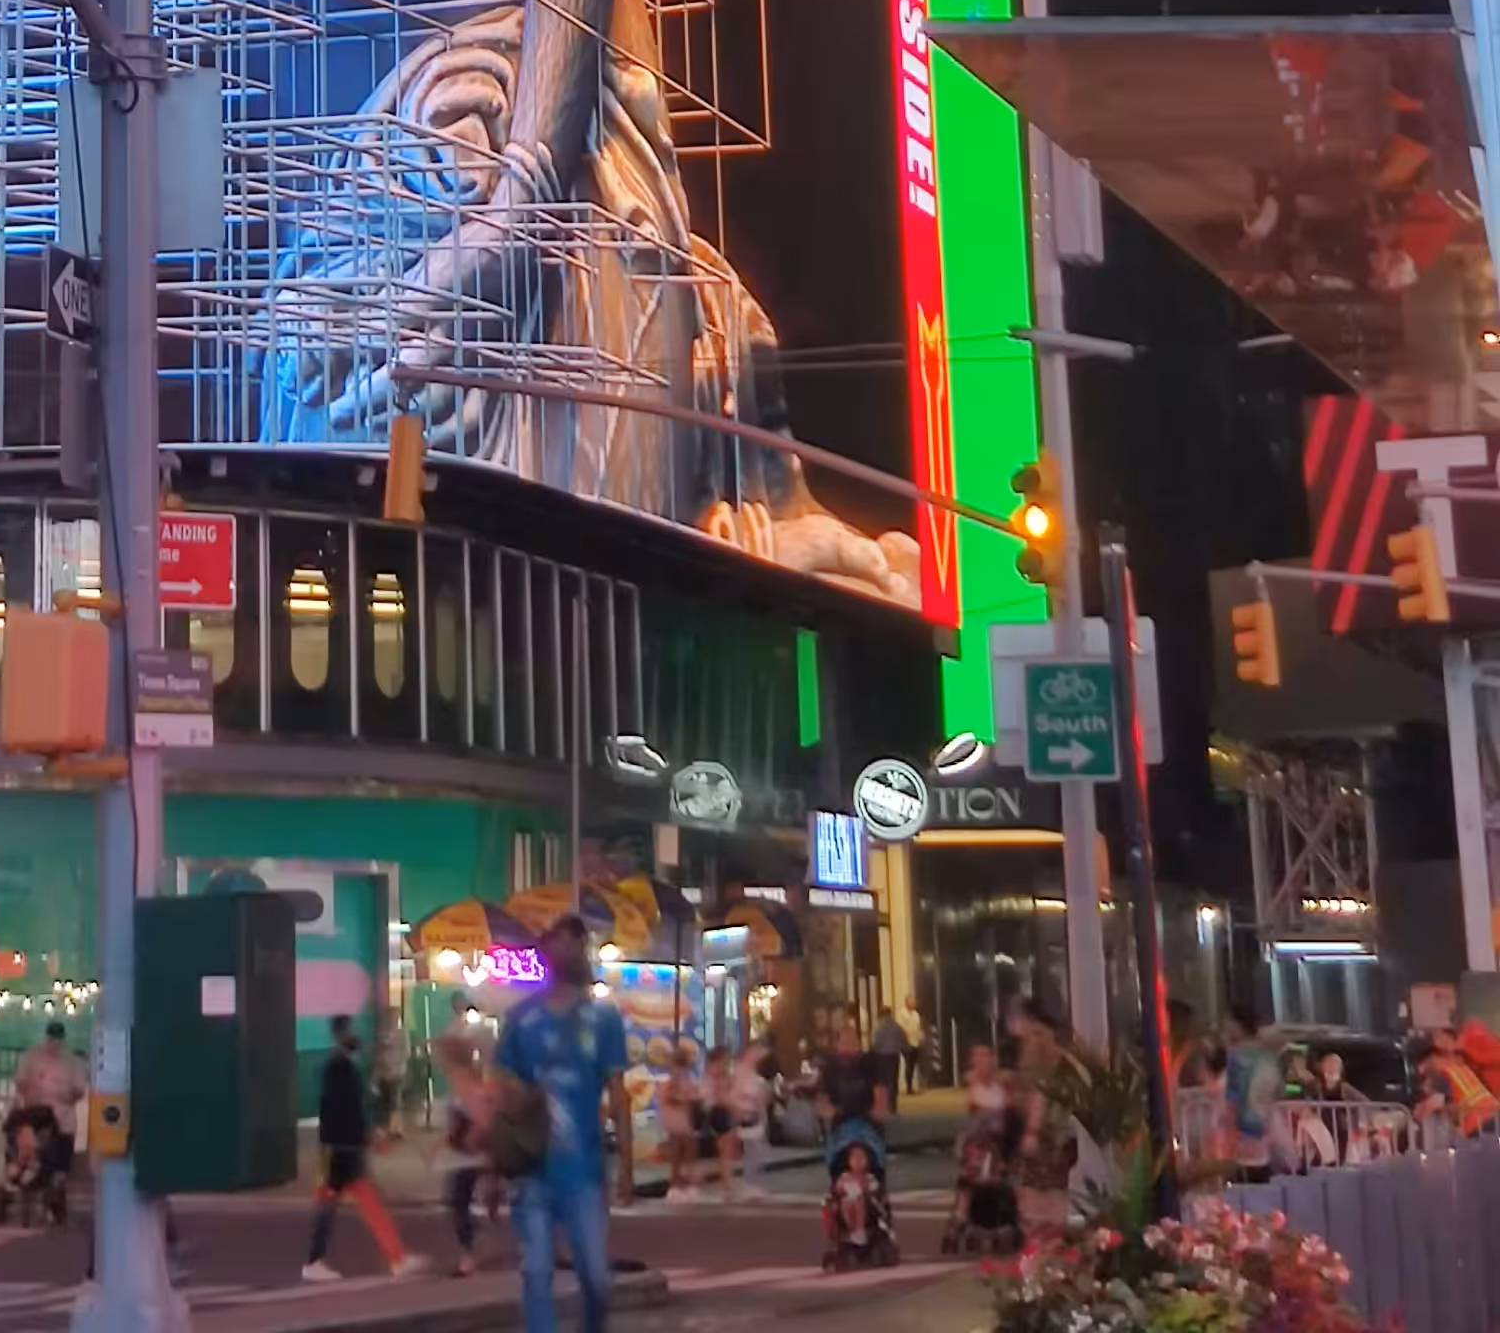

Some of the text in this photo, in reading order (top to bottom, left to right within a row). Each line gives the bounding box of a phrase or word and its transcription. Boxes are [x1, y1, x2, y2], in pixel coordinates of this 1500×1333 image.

[62, 277, 89, 321] ONE
[161, 523, 218, 543] ANDING
[159, 549, 180, 563] me
[1034, 713, 1109, 734] South
[933, 786, 1022, 821] TION
